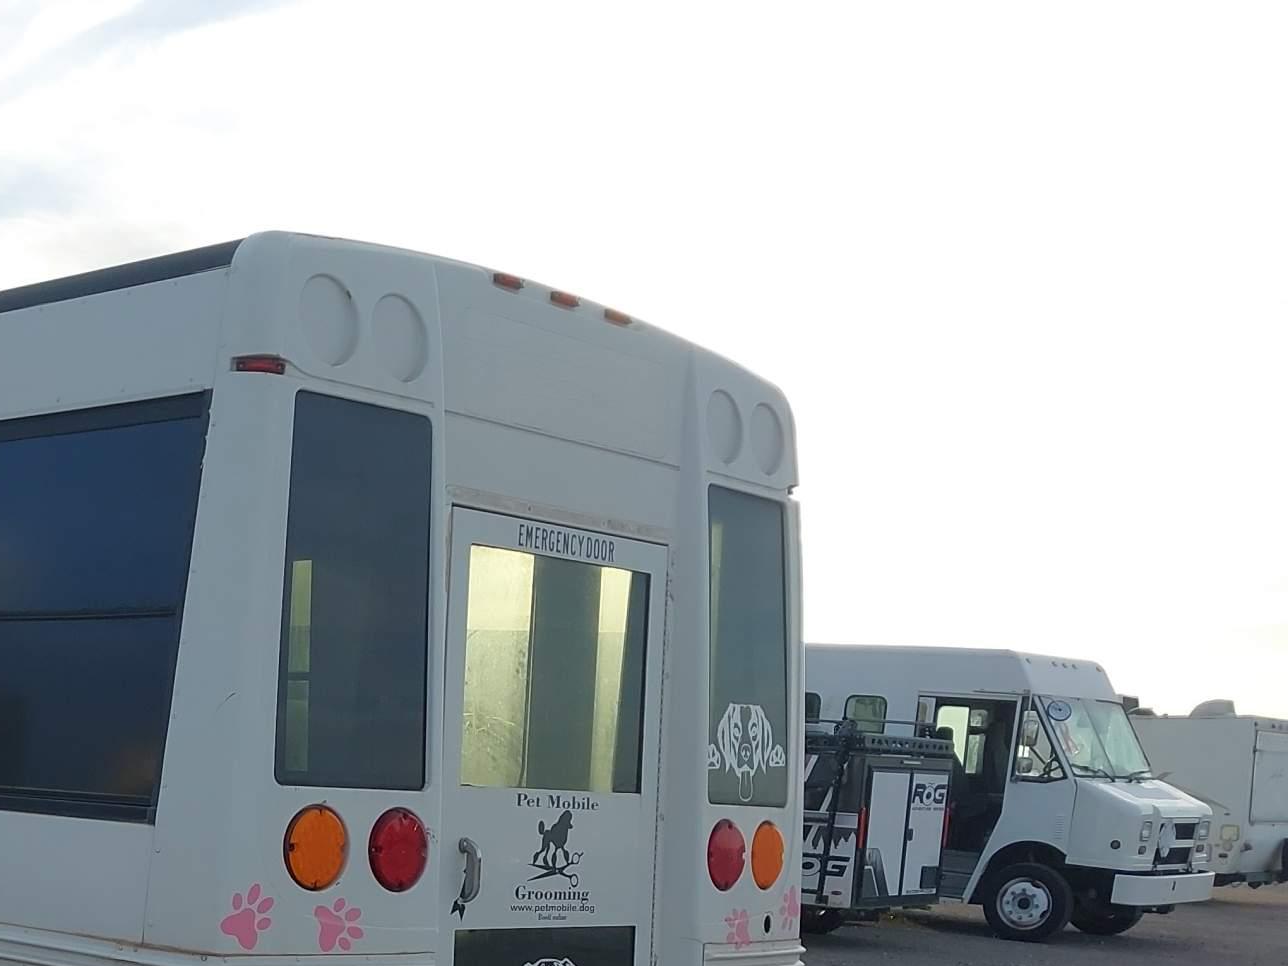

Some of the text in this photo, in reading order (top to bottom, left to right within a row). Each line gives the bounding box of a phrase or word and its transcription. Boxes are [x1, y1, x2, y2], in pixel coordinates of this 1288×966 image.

[518, 524, 615, 562] EMERGENCY DOOR
[517, 793, 599, 811] Pet Mobile
[515, 885, 589, 904] Grooming
[510, 902, 595, 913] www.petmobile.dog
